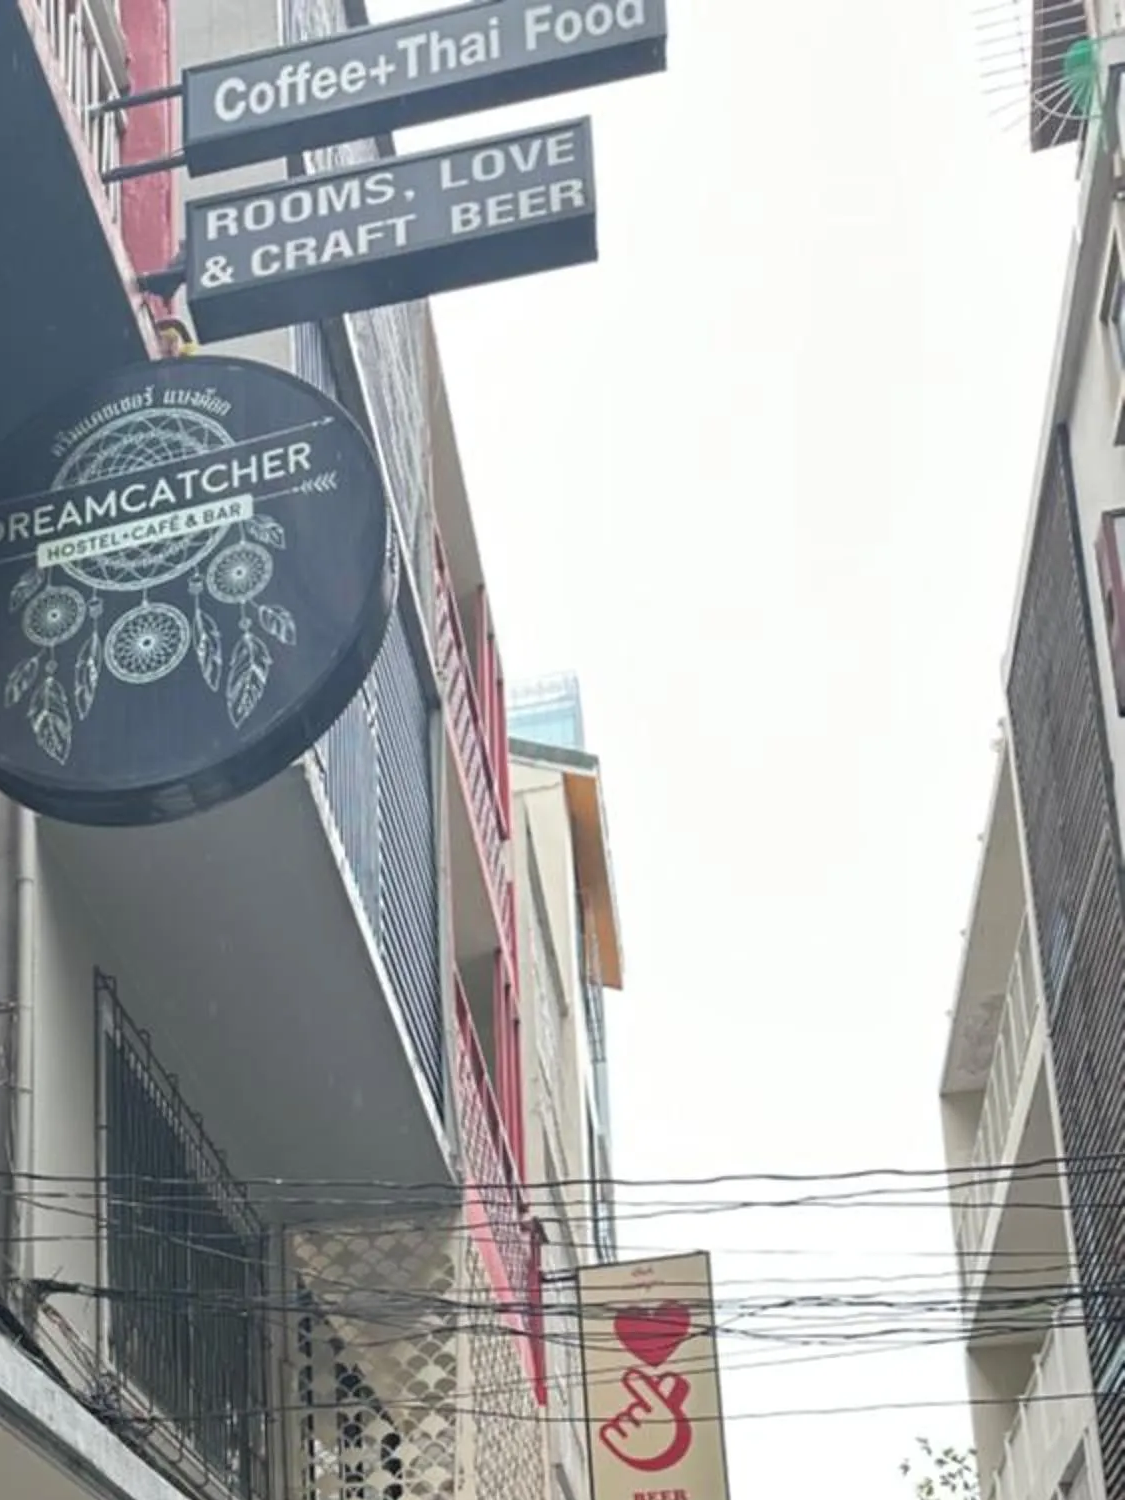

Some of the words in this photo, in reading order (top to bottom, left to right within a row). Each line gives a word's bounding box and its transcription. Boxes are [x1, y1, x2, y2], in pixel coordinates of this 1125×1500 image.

[524, 0, 645, 51] Food
[440, 131, 575, 190] LOVE
[200, 255, 235, 289] &
[251, 214, 418, 277] CRAFT
[450, 178, 586, 235] BEER
[185, 513, 199, 528] &
[203, 502, 243, 526] BAR
